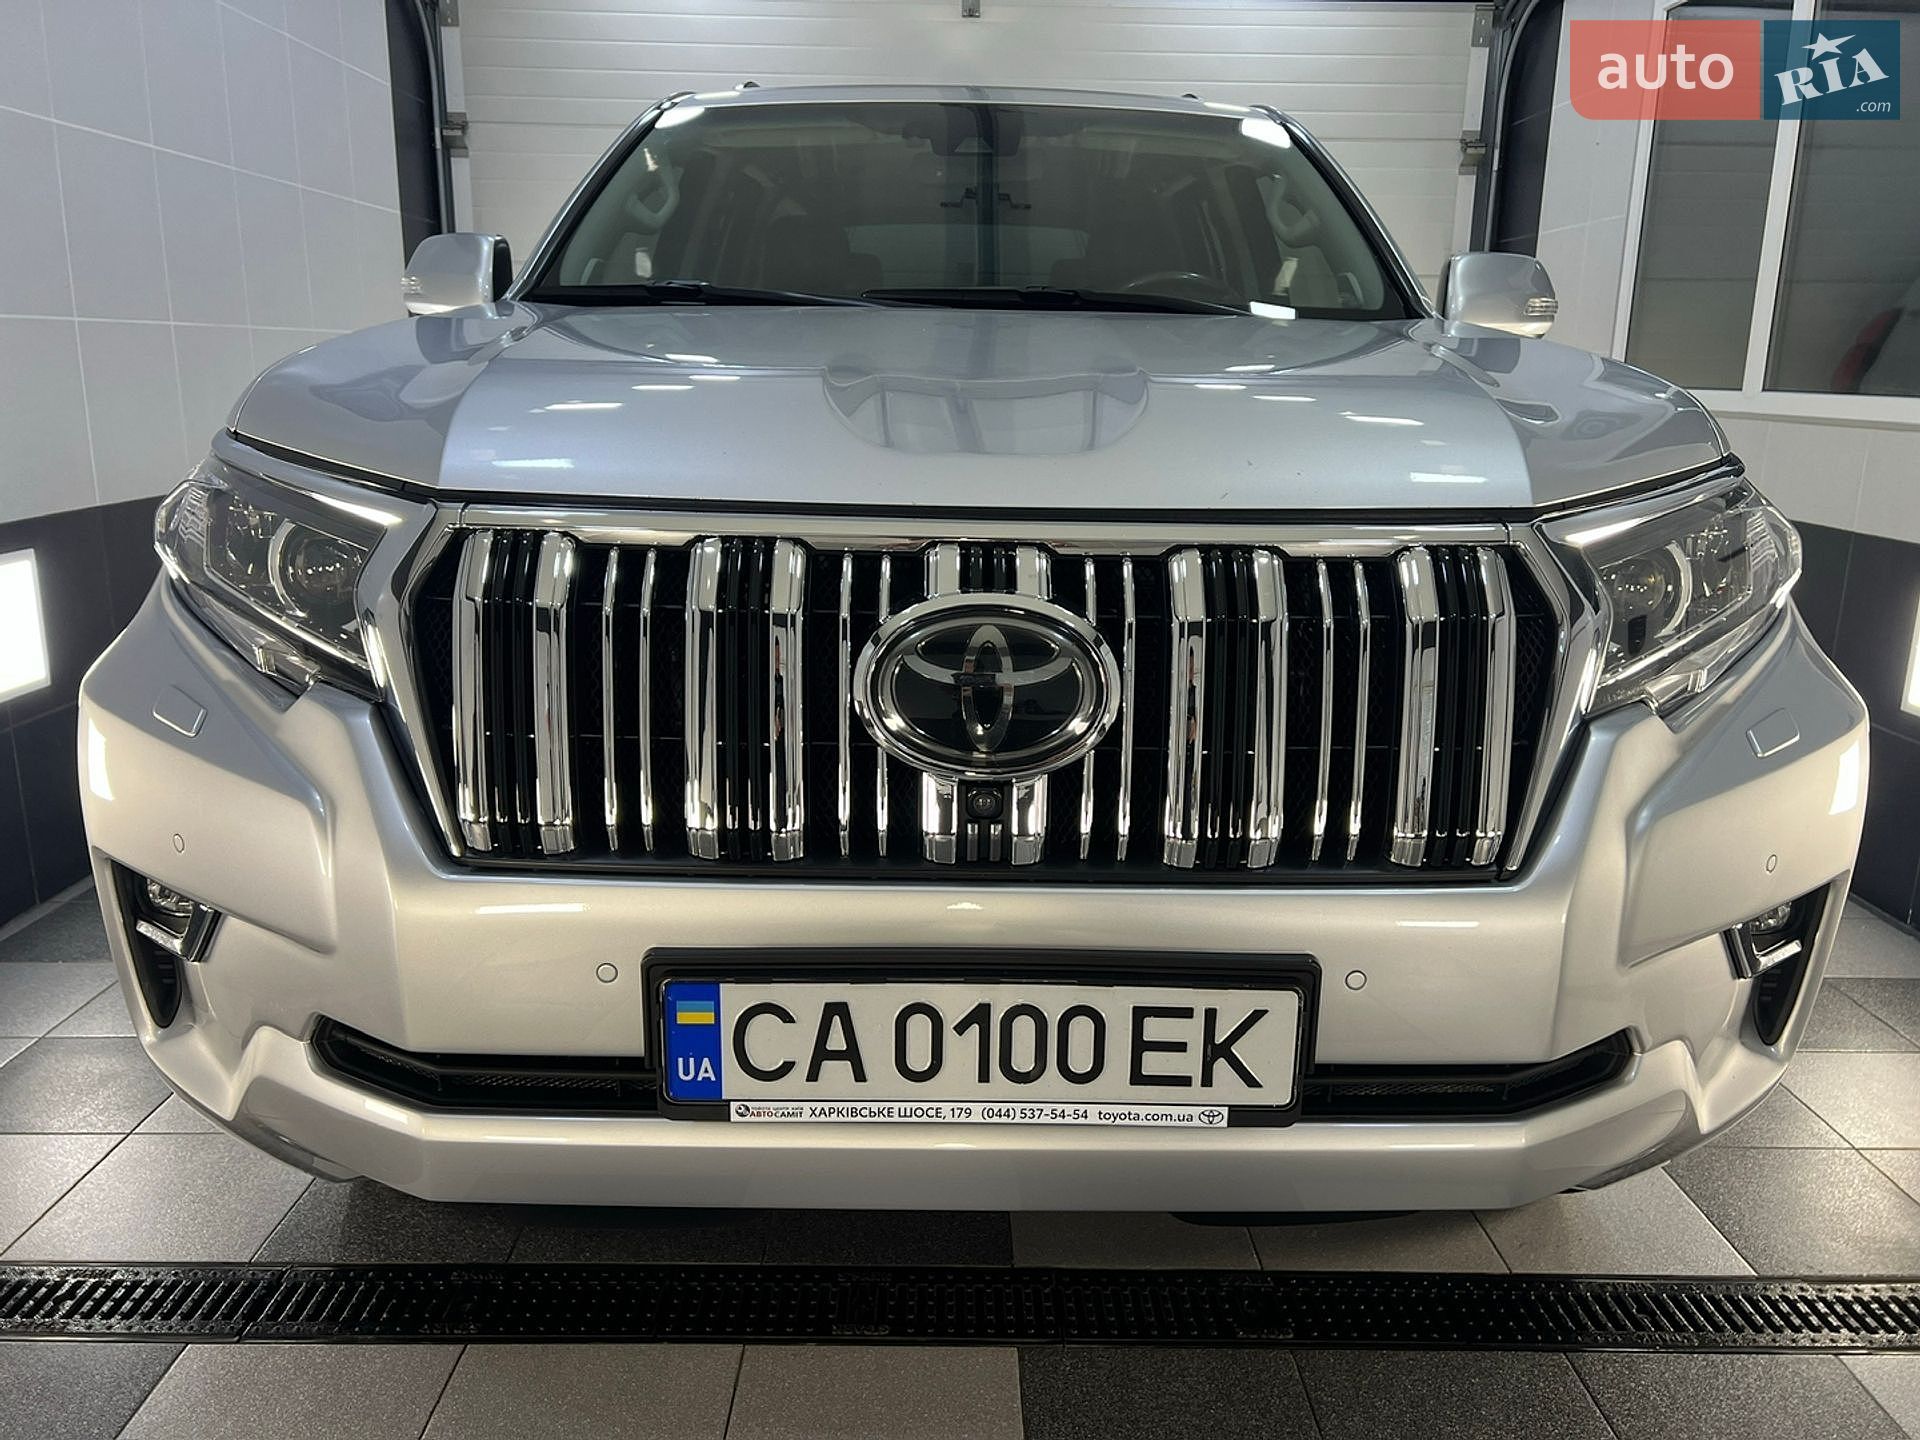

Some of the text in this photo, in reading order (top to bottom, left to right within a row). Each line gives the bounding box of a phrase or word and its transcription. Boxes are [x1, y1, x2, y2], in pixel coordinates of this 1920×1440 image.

[732, 1001, 1271, 1088] CA 0100 EK
[678, 1057, 716, 1083] UA
[809, 1106, 895, 1119] ХАРКІВСЬКЕ
[898, 1106, 946, 1120] ШОСЕ,
[950, 1107, 972, 1119] 179
[981, 1107, 1016, 1120] (044)
[1019, 1108, 1088, 1120] 537-54-54
[1098, 1110, 1193, 1125] toyota.com.ua
